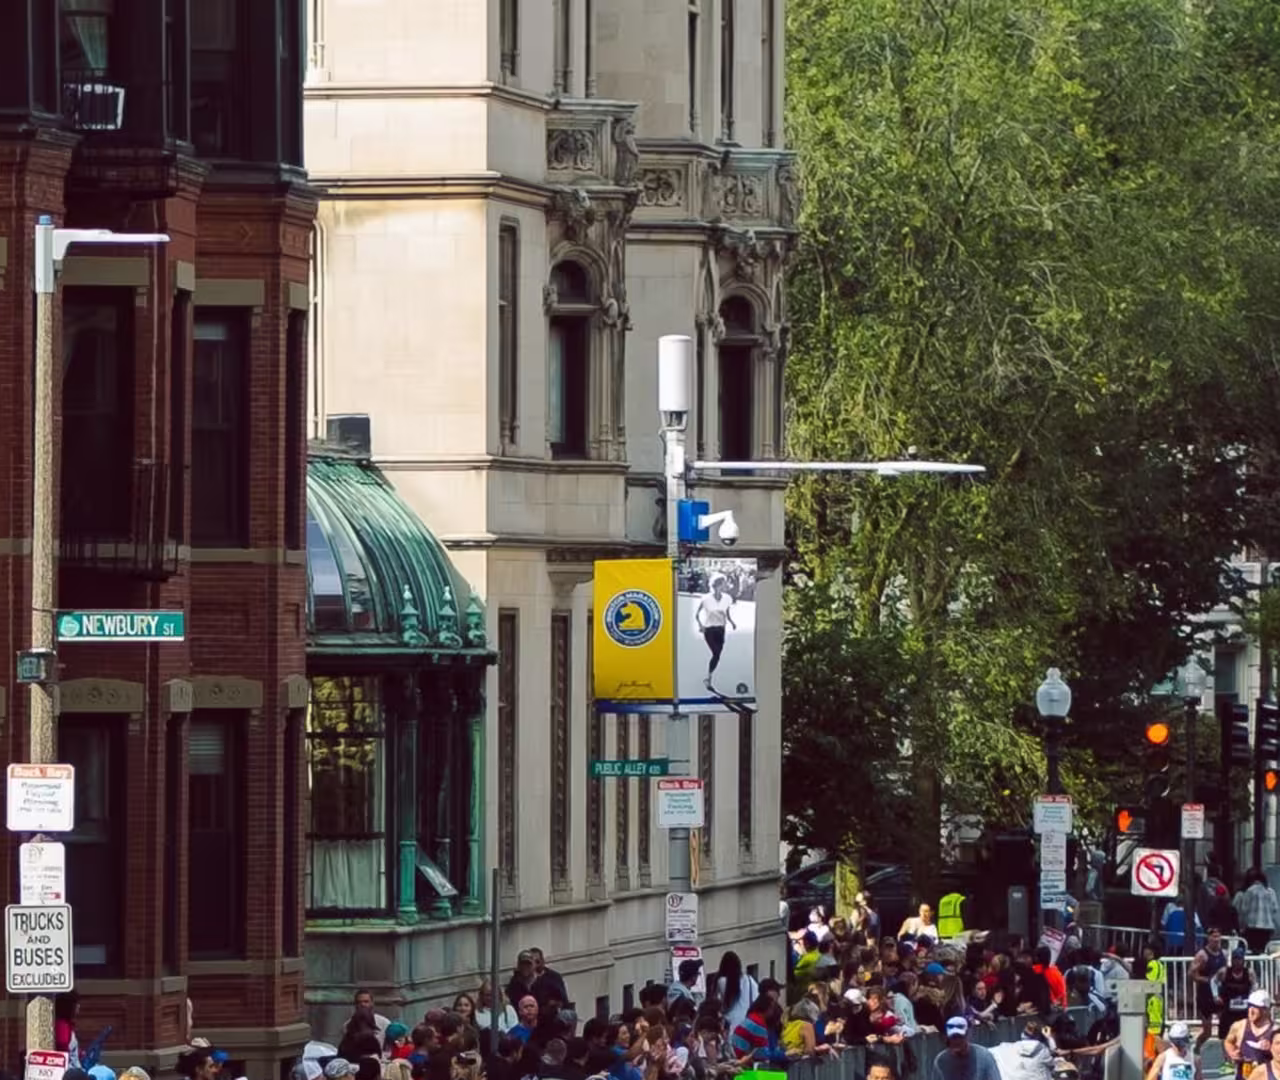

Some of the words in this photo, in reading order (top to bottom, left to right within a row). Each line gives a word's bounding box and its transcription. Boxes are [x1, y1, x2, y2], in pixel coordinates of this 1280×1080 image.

[82, 615, 159, 635] NEWBURY
[163, 623, 175, 635] ST
[595, 763, 622, 774] PUBLIC
[624, 763, 646, 774] ALLEY
[13, 912, 65, 931] TRUCKS
[27, 936, 51, 944] AND
[14, 948, 65, 967] BUSES
[12, 973, 66, 986] EXCLUDED
